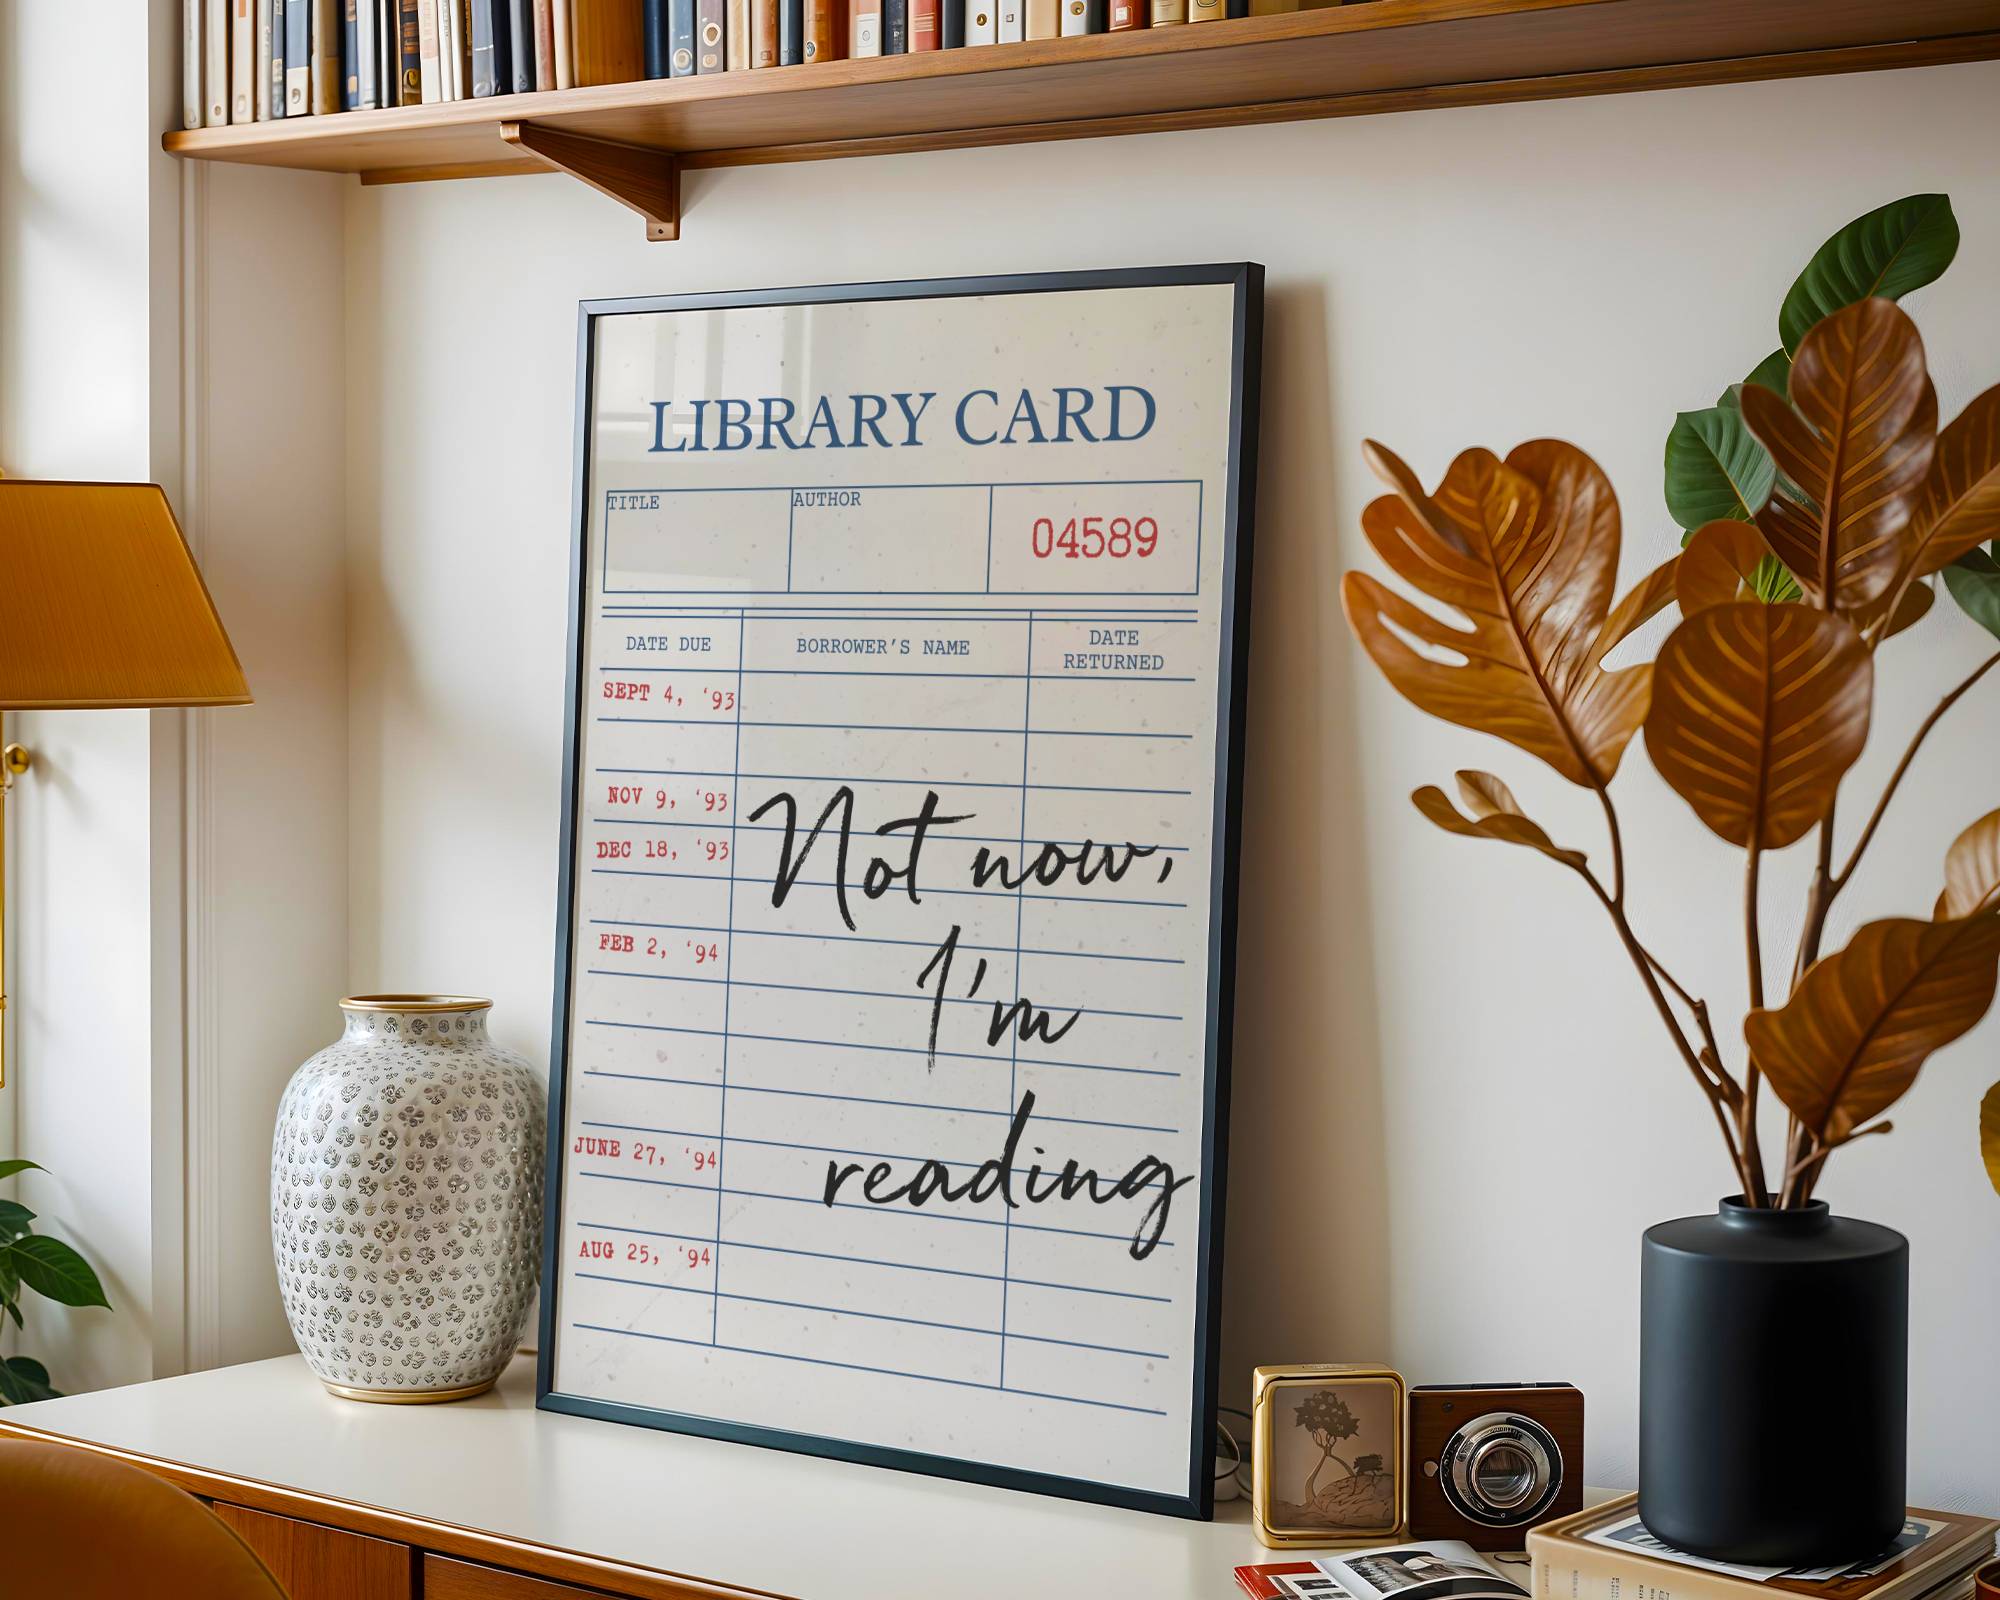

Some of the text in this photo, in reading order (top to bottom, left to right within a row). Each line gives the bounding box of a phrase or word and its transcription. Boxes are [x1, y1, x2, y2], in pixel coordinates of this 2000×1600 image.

[648, 386, 1156, 453] LIBRARY CARD
[607, 495, 660, 511] TITLE
[793, 491, 862, 507] AUTHOR
[1031, 517, 1159, 559] 04589
[626, 637, 710, 651] DATE DUE
[923, 640, 969, 655] NAME
[1089, 629, 1140, 646] DATE
[1064, 654, 1164, 670] RETURNED
[603, 681, 651, 703] SEPT
[664, 686, 684, 705] 4,
[608, 785, 644, 805] NOV
[656, 791, 676, 811] 9,
[595, 840, 632, 860] DEC
[645, 840, 677, 860] 18,
[747, 786, 1173, 932] Not now,
[599, 933, 635, 953] FEB
[647, 936, 667, 958] 2,
[917, 925, 1084, 1075] I'm
[574, 1136, 621, 1159] JUNE
[633, 1143, 666, 1164] 27,
[824, 1090, 1194, 1260] reading
[578, 1240, 614, 1260] AUG
[627, 1243, 660, 1264] 25,
